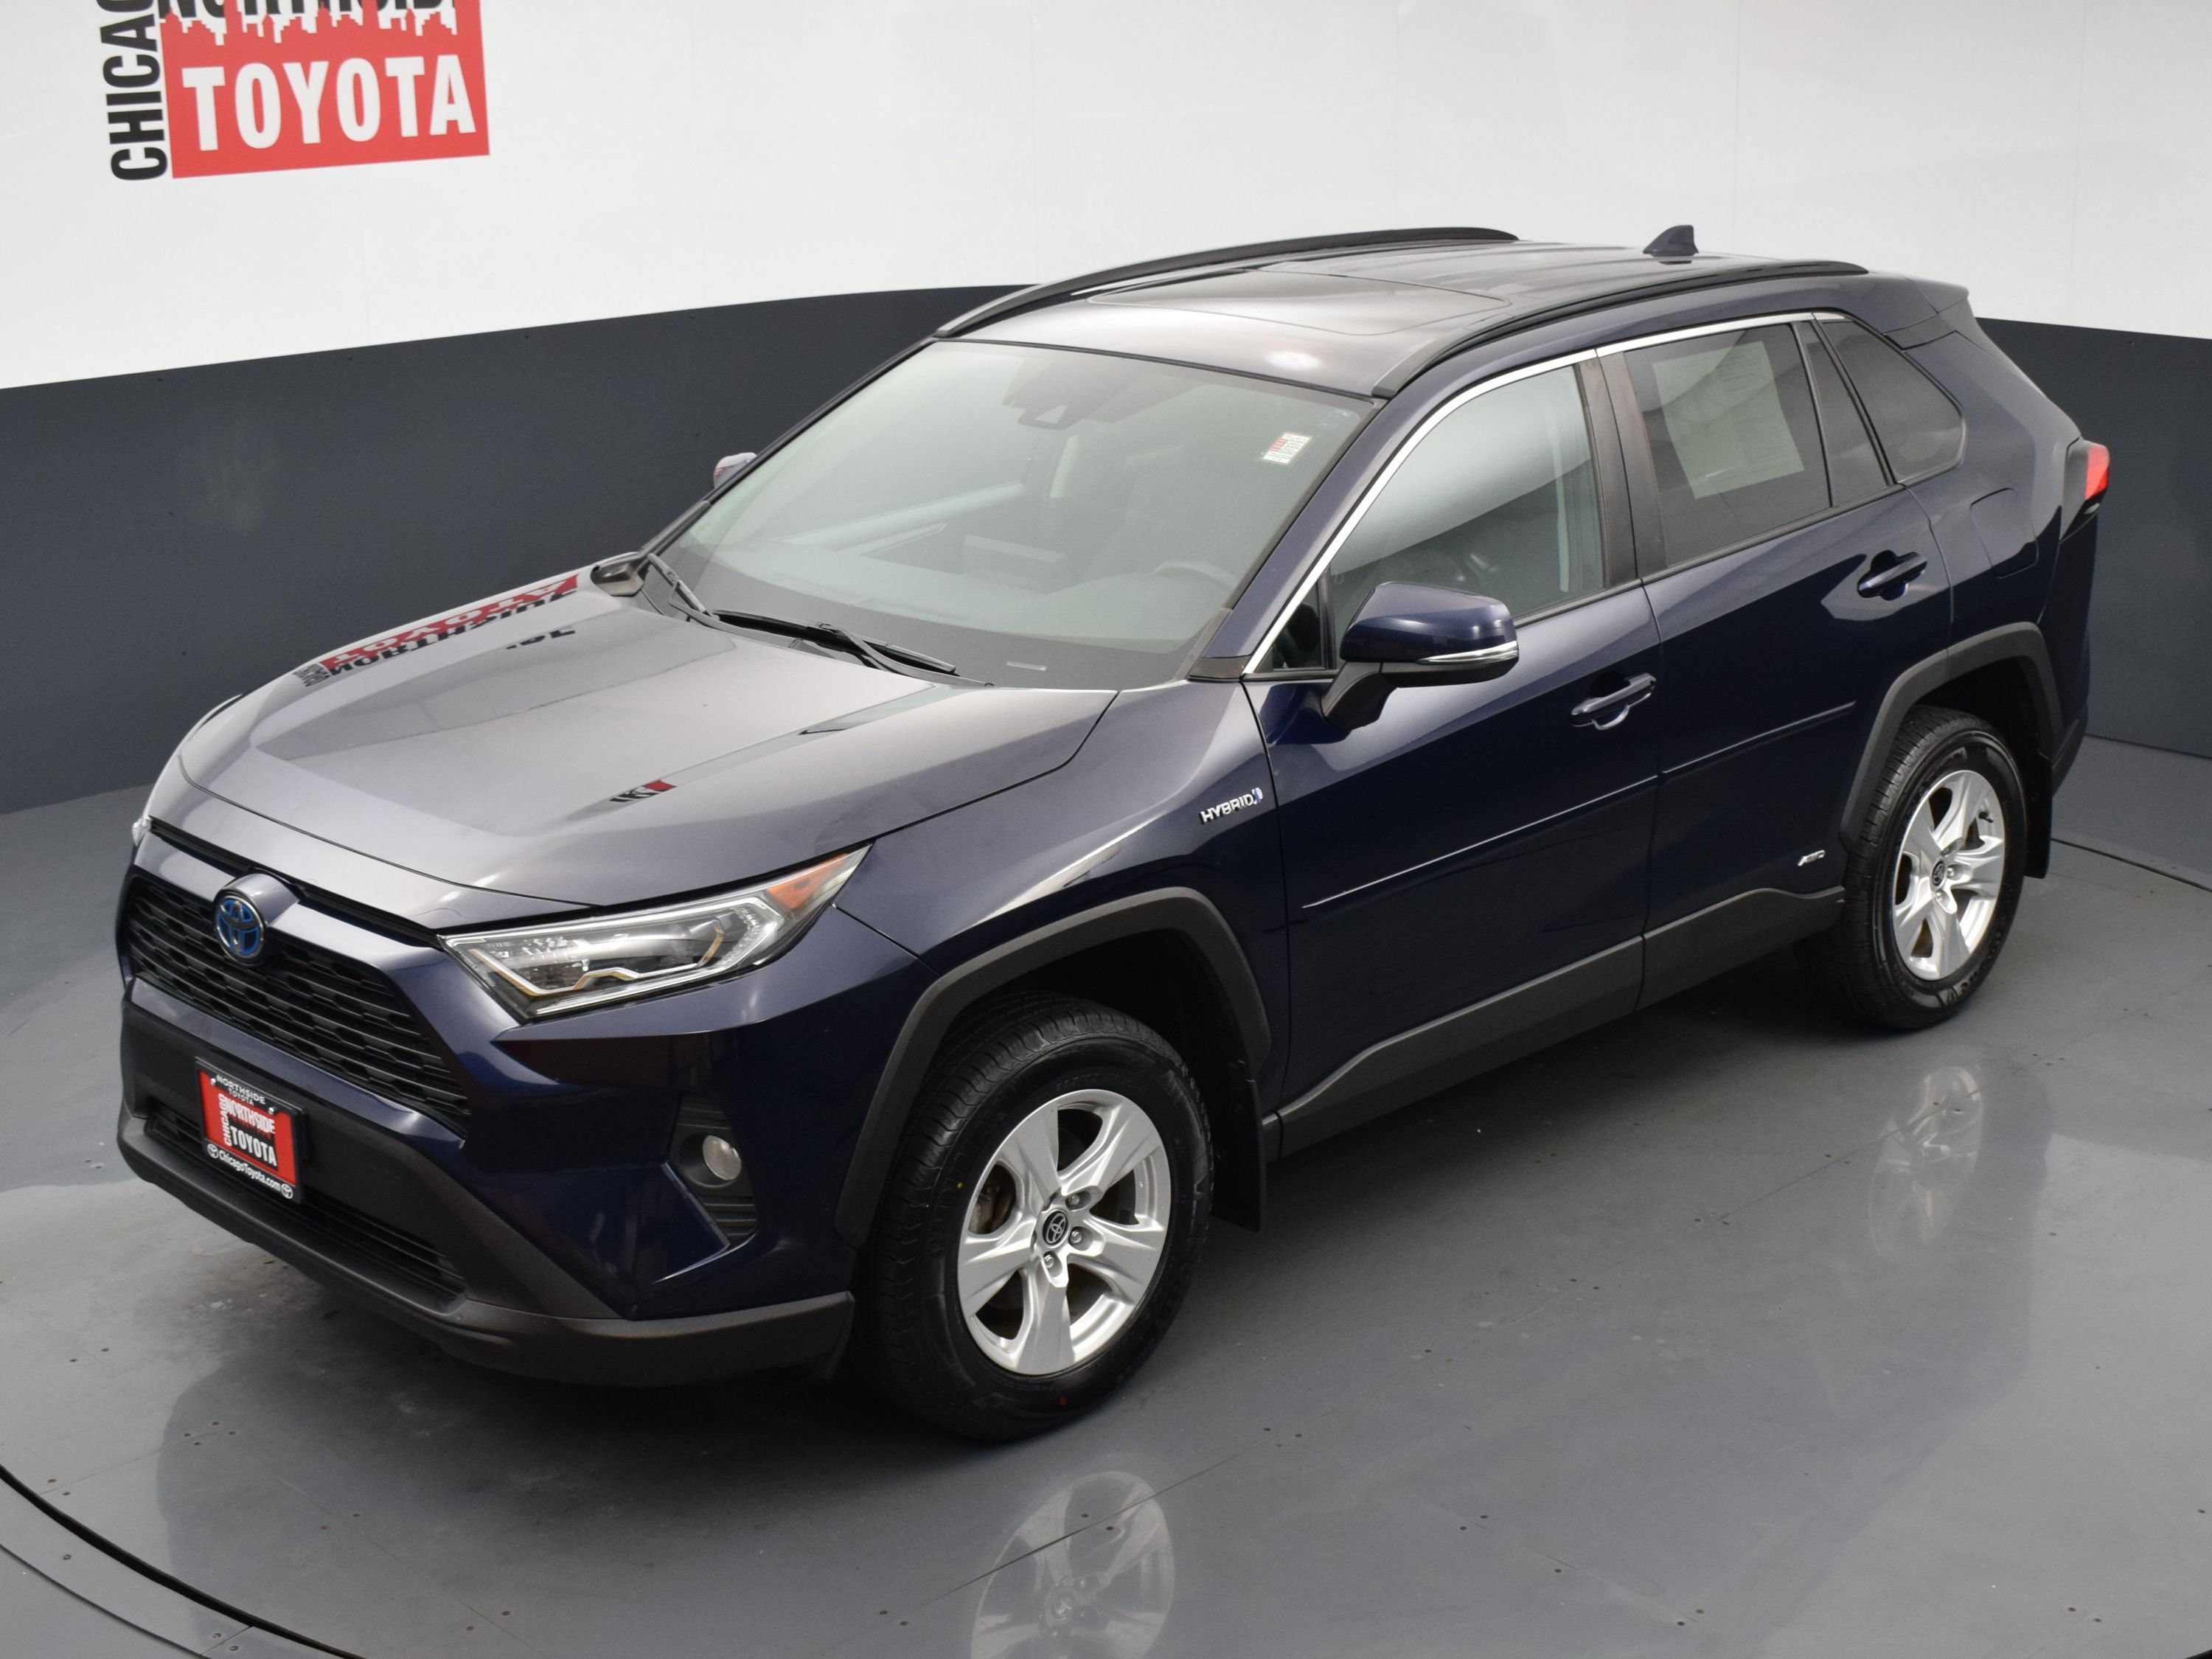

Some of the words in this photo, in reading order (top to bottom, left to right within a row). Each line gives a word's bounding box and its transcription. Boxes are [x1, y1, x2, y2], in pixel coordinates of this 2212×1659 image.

[181, 55, 476, 151] TOYOTA
[1200, 793, 1254, 823] HYBRID
[216, 1075, 266, 1105] NORTHSIDE
[228, 1088, 254, 1106] TOYOTA
[230, 1125, 277, 1167] TOYOTA
[219, 1150, 282, 1192] ChicagoToyota.com
